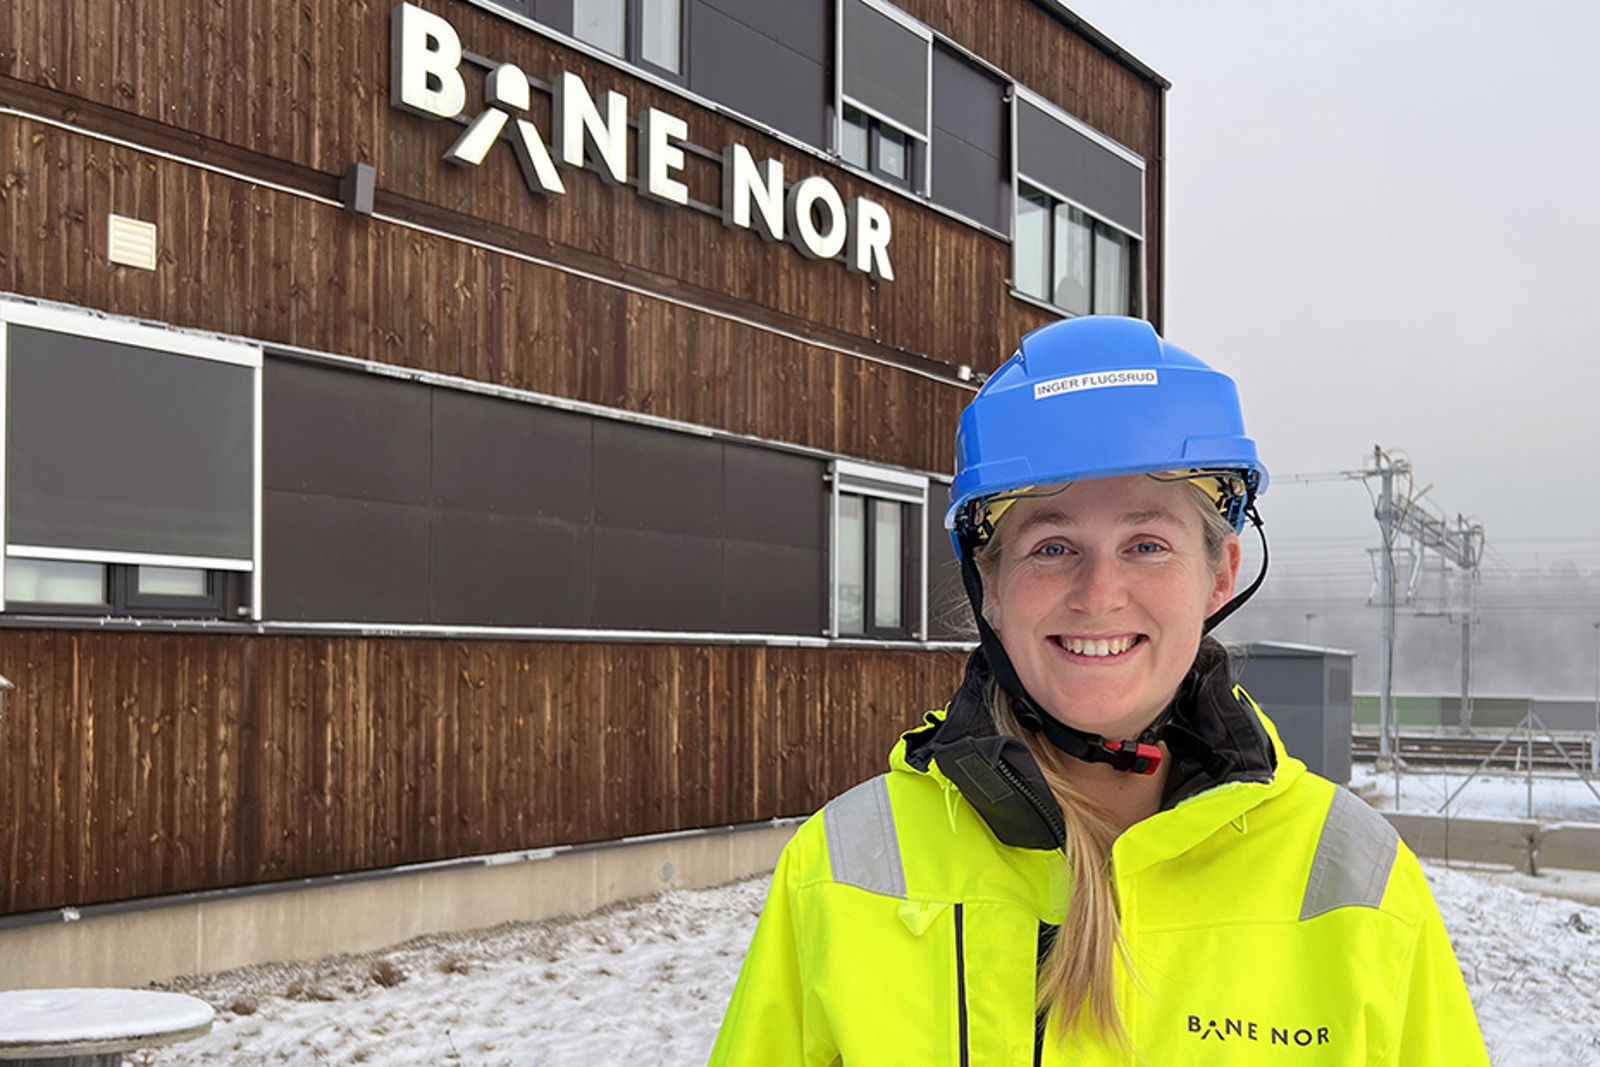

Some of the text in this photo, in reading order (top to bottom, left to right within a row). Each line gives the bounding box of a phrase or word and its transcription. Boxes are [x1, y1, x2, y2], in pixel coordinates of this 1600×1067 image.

[723, 141, 895, 282] NOR
[1037, 371, 1156, 395] INGER FLUGSRUD
[1271, 1026, 1330, 1047] NOR
